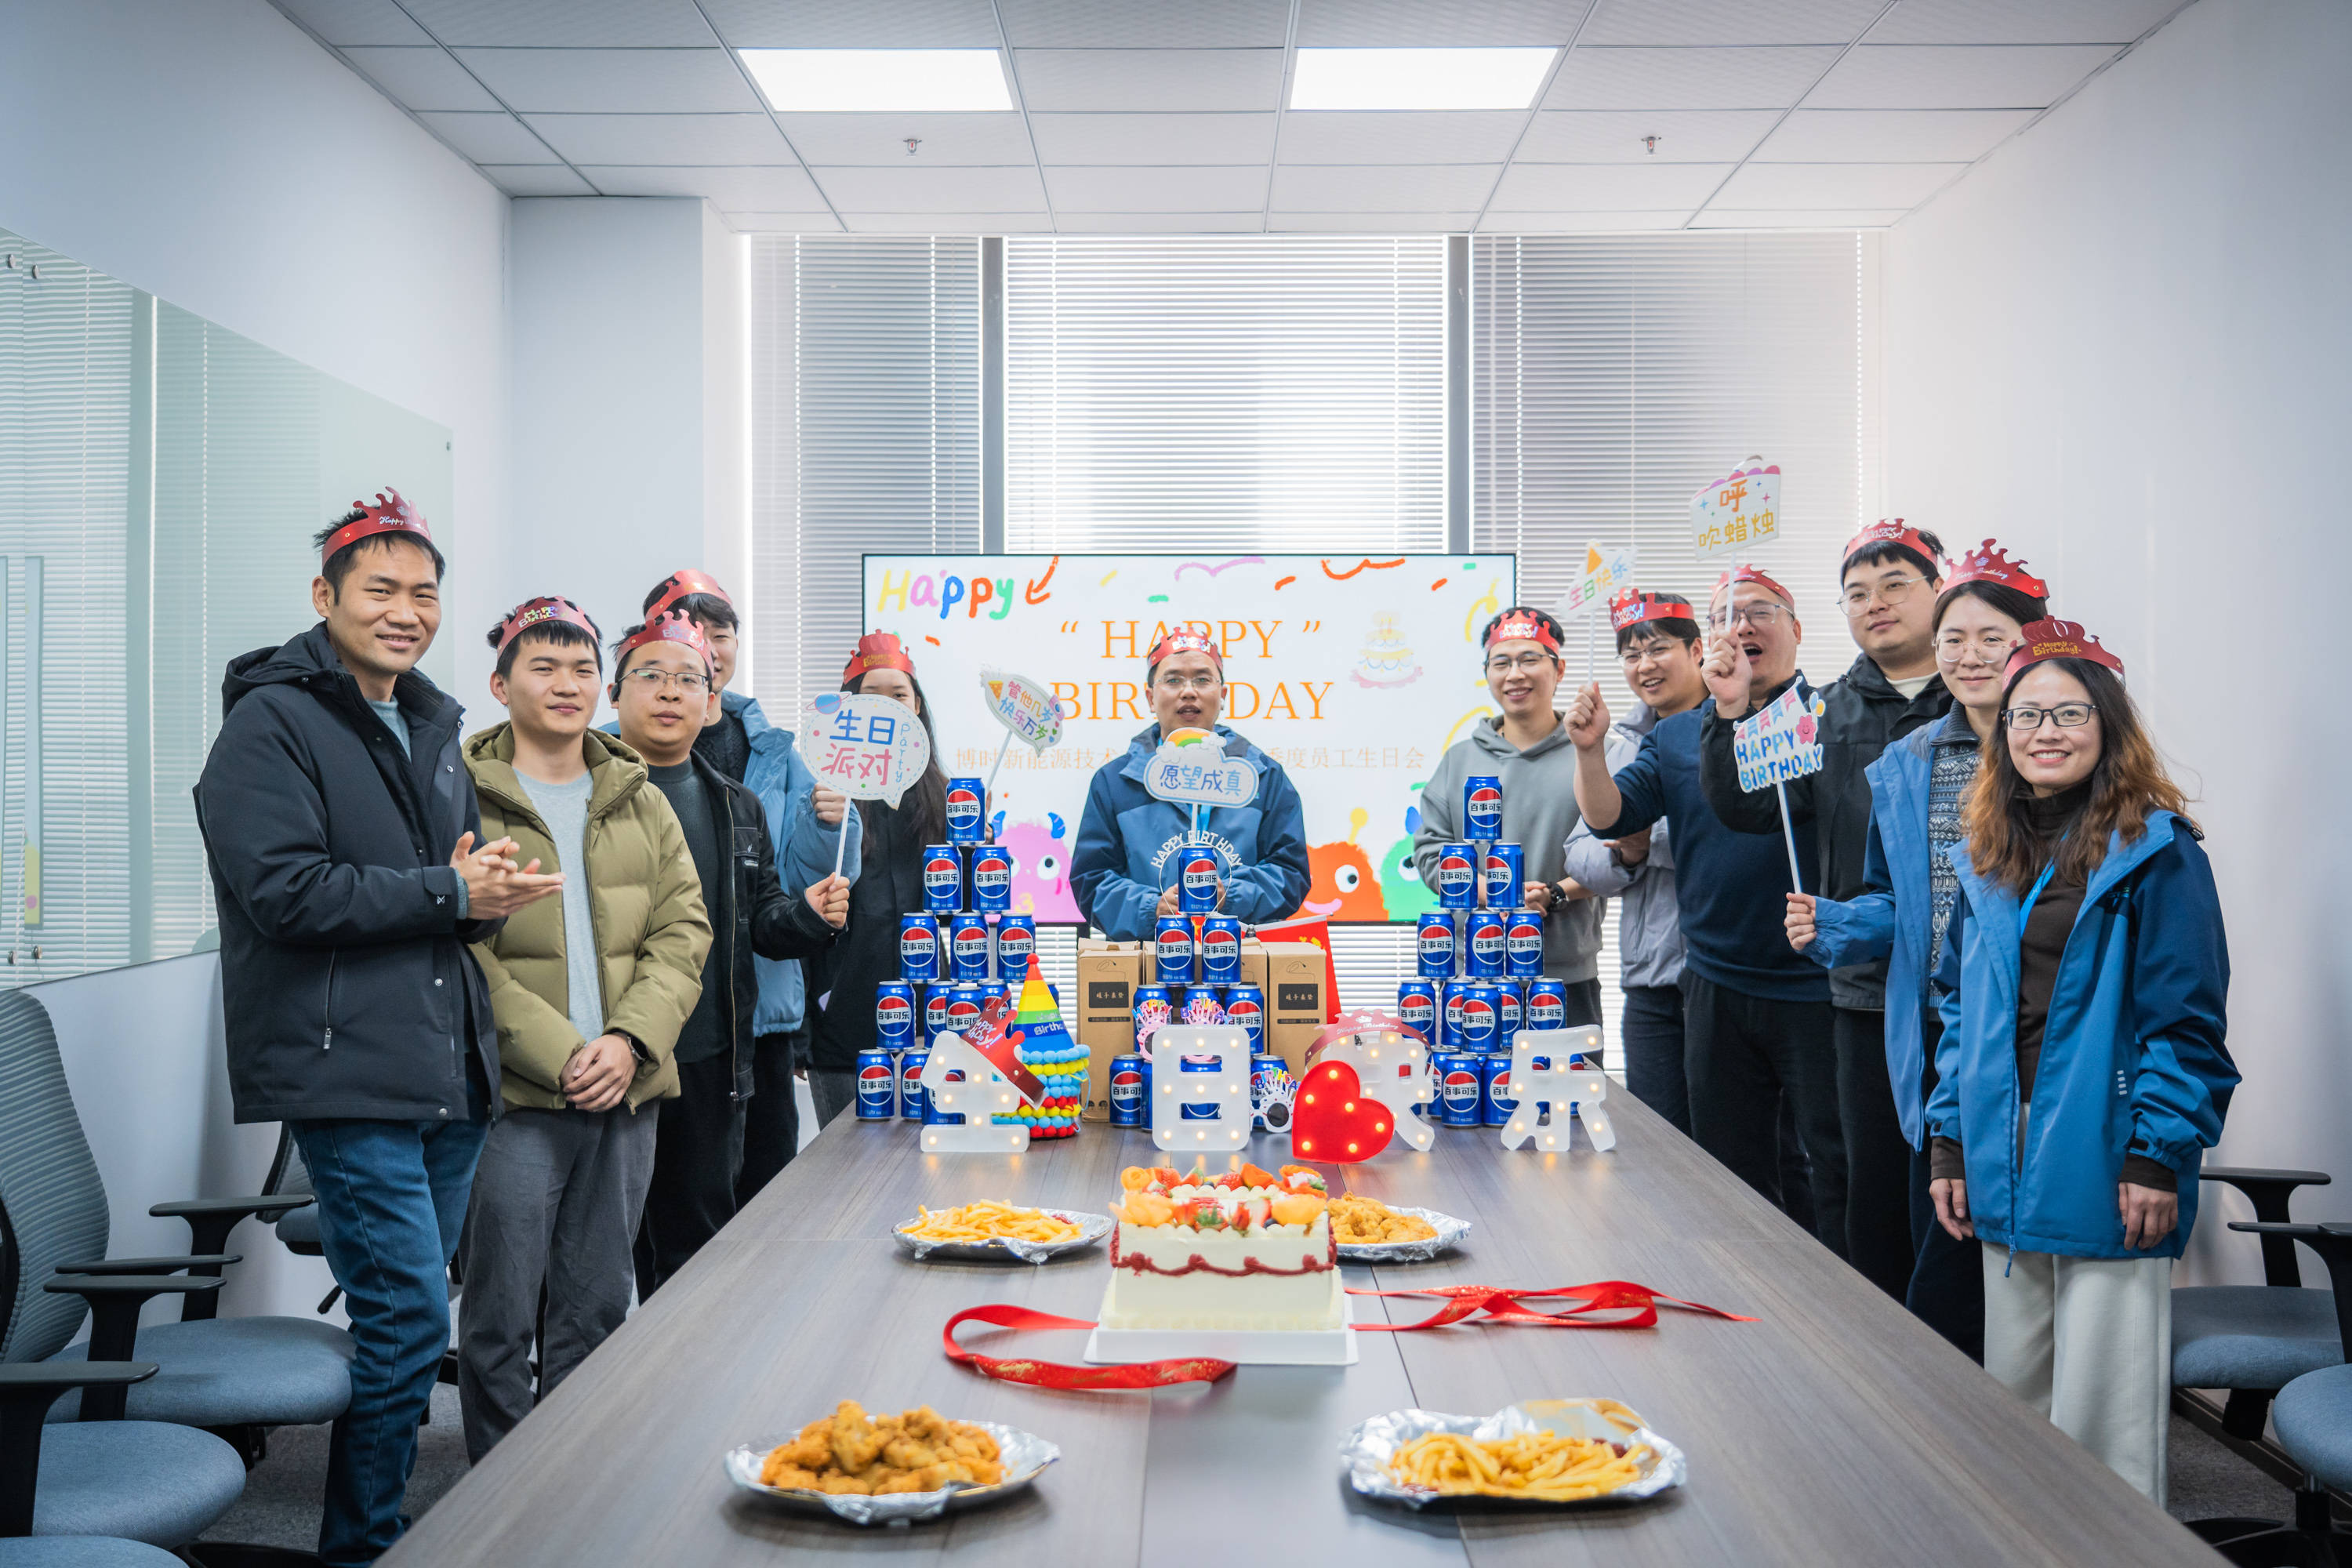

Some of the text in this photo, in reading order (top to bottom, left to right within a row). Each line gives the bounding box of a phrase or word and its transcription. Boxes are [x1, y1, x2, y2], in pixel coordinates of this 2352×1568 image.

[1719, 479, 1748, 512] 呼
[379, 516, 404, 525] Happy
[1699, 508, 1774, 550] 吹蜡烛
[877, 570, 1014, 620] Happy
[1008, 681, 1054, 722] 管他几岁
[1049, 682, 1334, 720] BIRDAY
[999, 697, 1048, 741] 快乐万岁
[829, 709, 895, 745] 生日
[1736, 728, 1795, 764] HAPPY
[821, 743, 892, 786] 派对
[1740, 747, 1820, 789] BIRTHDAY
[1160, 765, 1241, 797] 愿望成真
[947, 804, 978, 813] 百事可乐
[1150, 833, 1184, 869] HAPPY
[926, 873, 957, 882] 百事可乐
[977, 873, 1008, 882] 百事可乐
[1185, 874, 1217, 884] 百事可乐
[902, 942, 934, 951] 百事可乐
[956, 942, 988, 951] 百事可乐
[1000, 942, 1032, 951] 百事可乐
[1159, 945, 1191, 953] 百事可乐
[1421, 940, 1453, 949] 百事可乐
[1509, 940, 1541, 949] 百事可乐
[1203, 945, 1236, 954] 百事可乐
[1131, 999, 1173, 1020] HAPPY
[1180, 997, 1232, 1025] BIRTHDAY
[1401, 1010, 1433, 1018] 百事可乐
[1504, 1009, 1519, 1018] 可乐
[1530, 1008, 1563, 1018] 百事可乐
[878, 1011, 909, 1020] 百事可乐
[928, 1011, 945, 1020] 百事
[1463, 1015, 1493, 1024] 百事可乐
[860, 1081, 892, 1090] 百事可乐
[904, 1081, 920, 1090] 百事
[1113, 1087, 1141, 1095] 百事可
[1445, 1087, 1477, 1095] 百事可乐
